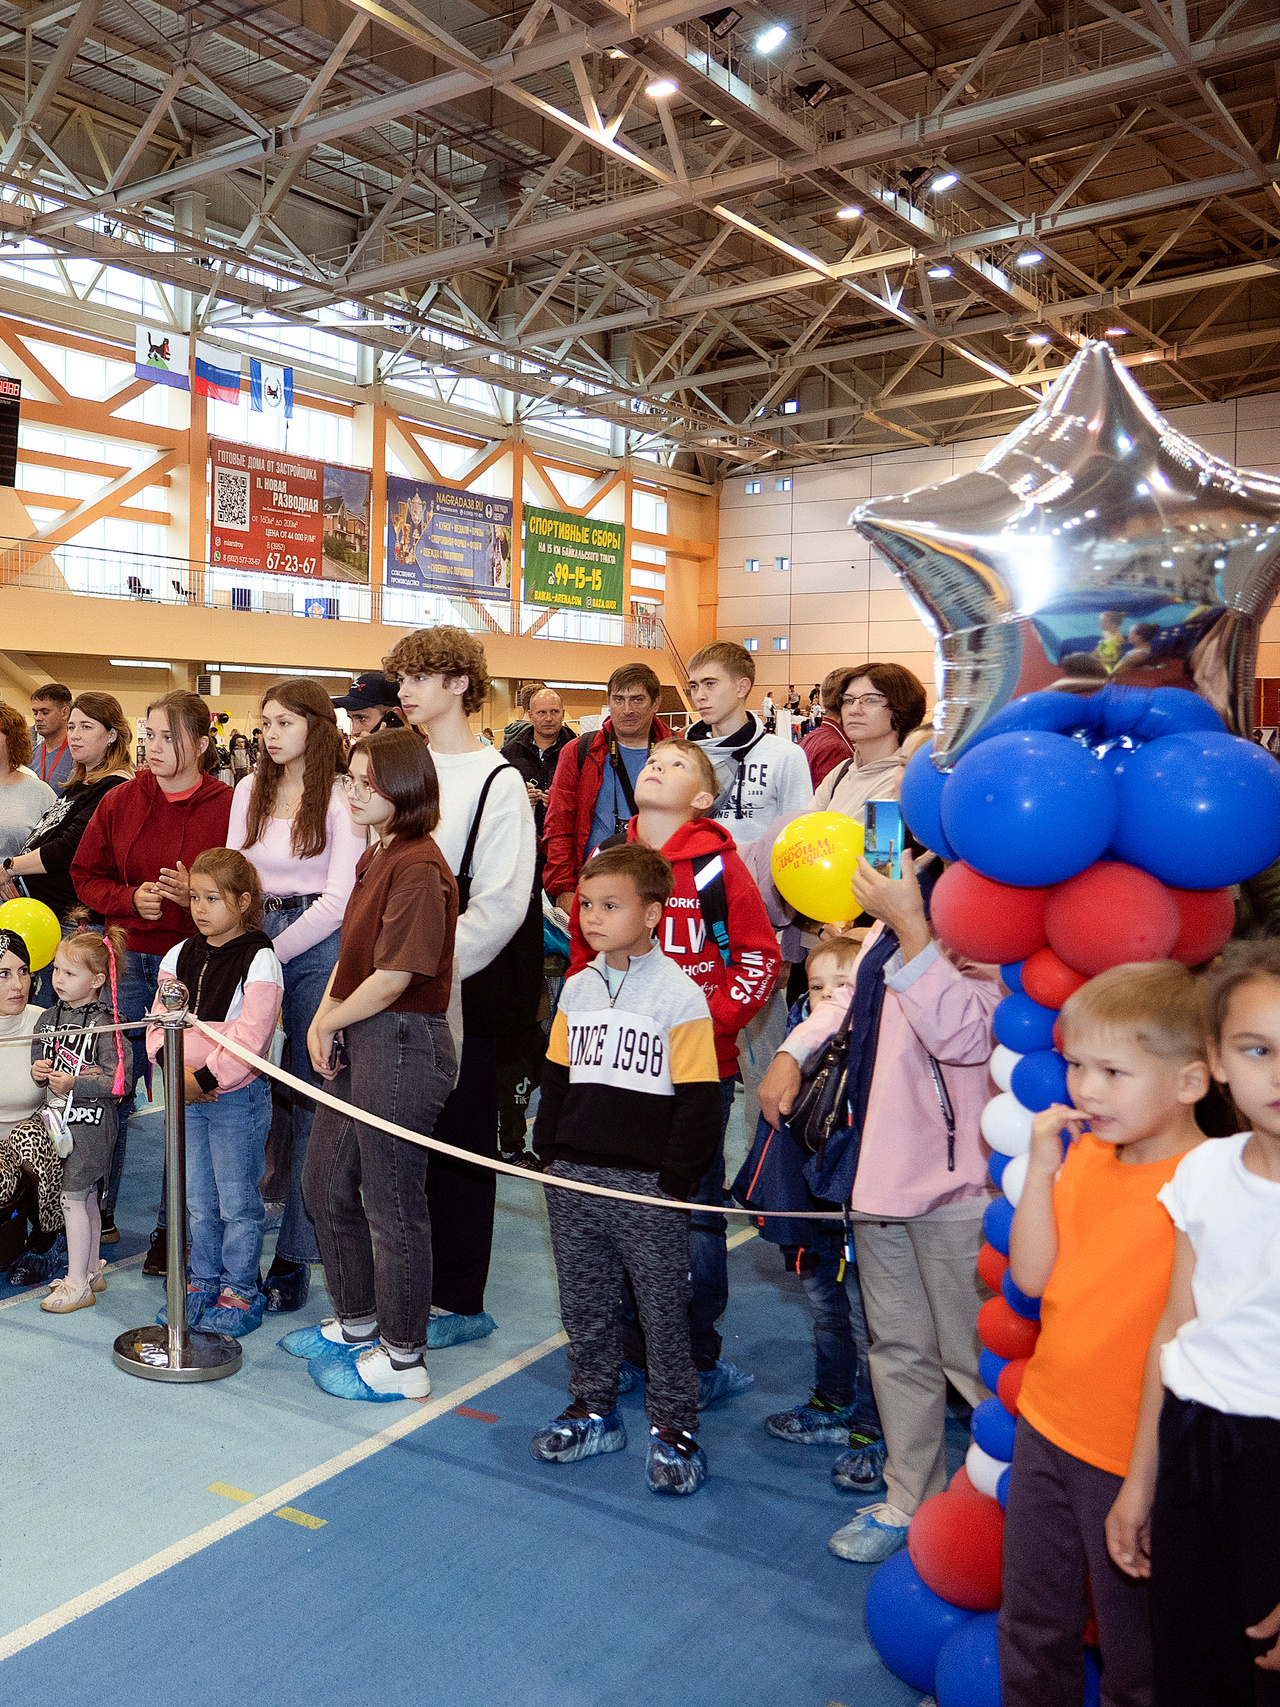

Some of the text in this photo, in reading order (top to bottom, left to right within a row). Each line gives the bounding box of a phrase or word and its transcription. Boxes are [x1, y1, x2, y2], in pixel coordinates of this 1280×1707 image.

[217, 449, 318, 481] ГОТОВЫЕ ДОМА ОТ ЗАСТРОЙЩИКА
[264, 477, 287, 493] НОВАЯ
[272, 491, 319, 513] РАЗВОДНАЯ
[436, 492, 484, 511] NAGRADA38.RU
[265, 528, 279, 538] ЦЕНА
[529, 515, 621, 550] СПОРТИВНЫЕ СБОРЫ
[266, 552, 317, 574] 67-23-67
[538, 542, 546, 553] НА
[561, 545, 599, 562] БАЙКАЛЬСКОГО
[555, 562, 602, 591] 99-15-15
[730, 950, 764, 1005] WAYS
[567, 1023, 663, 1078] INCE 1998
